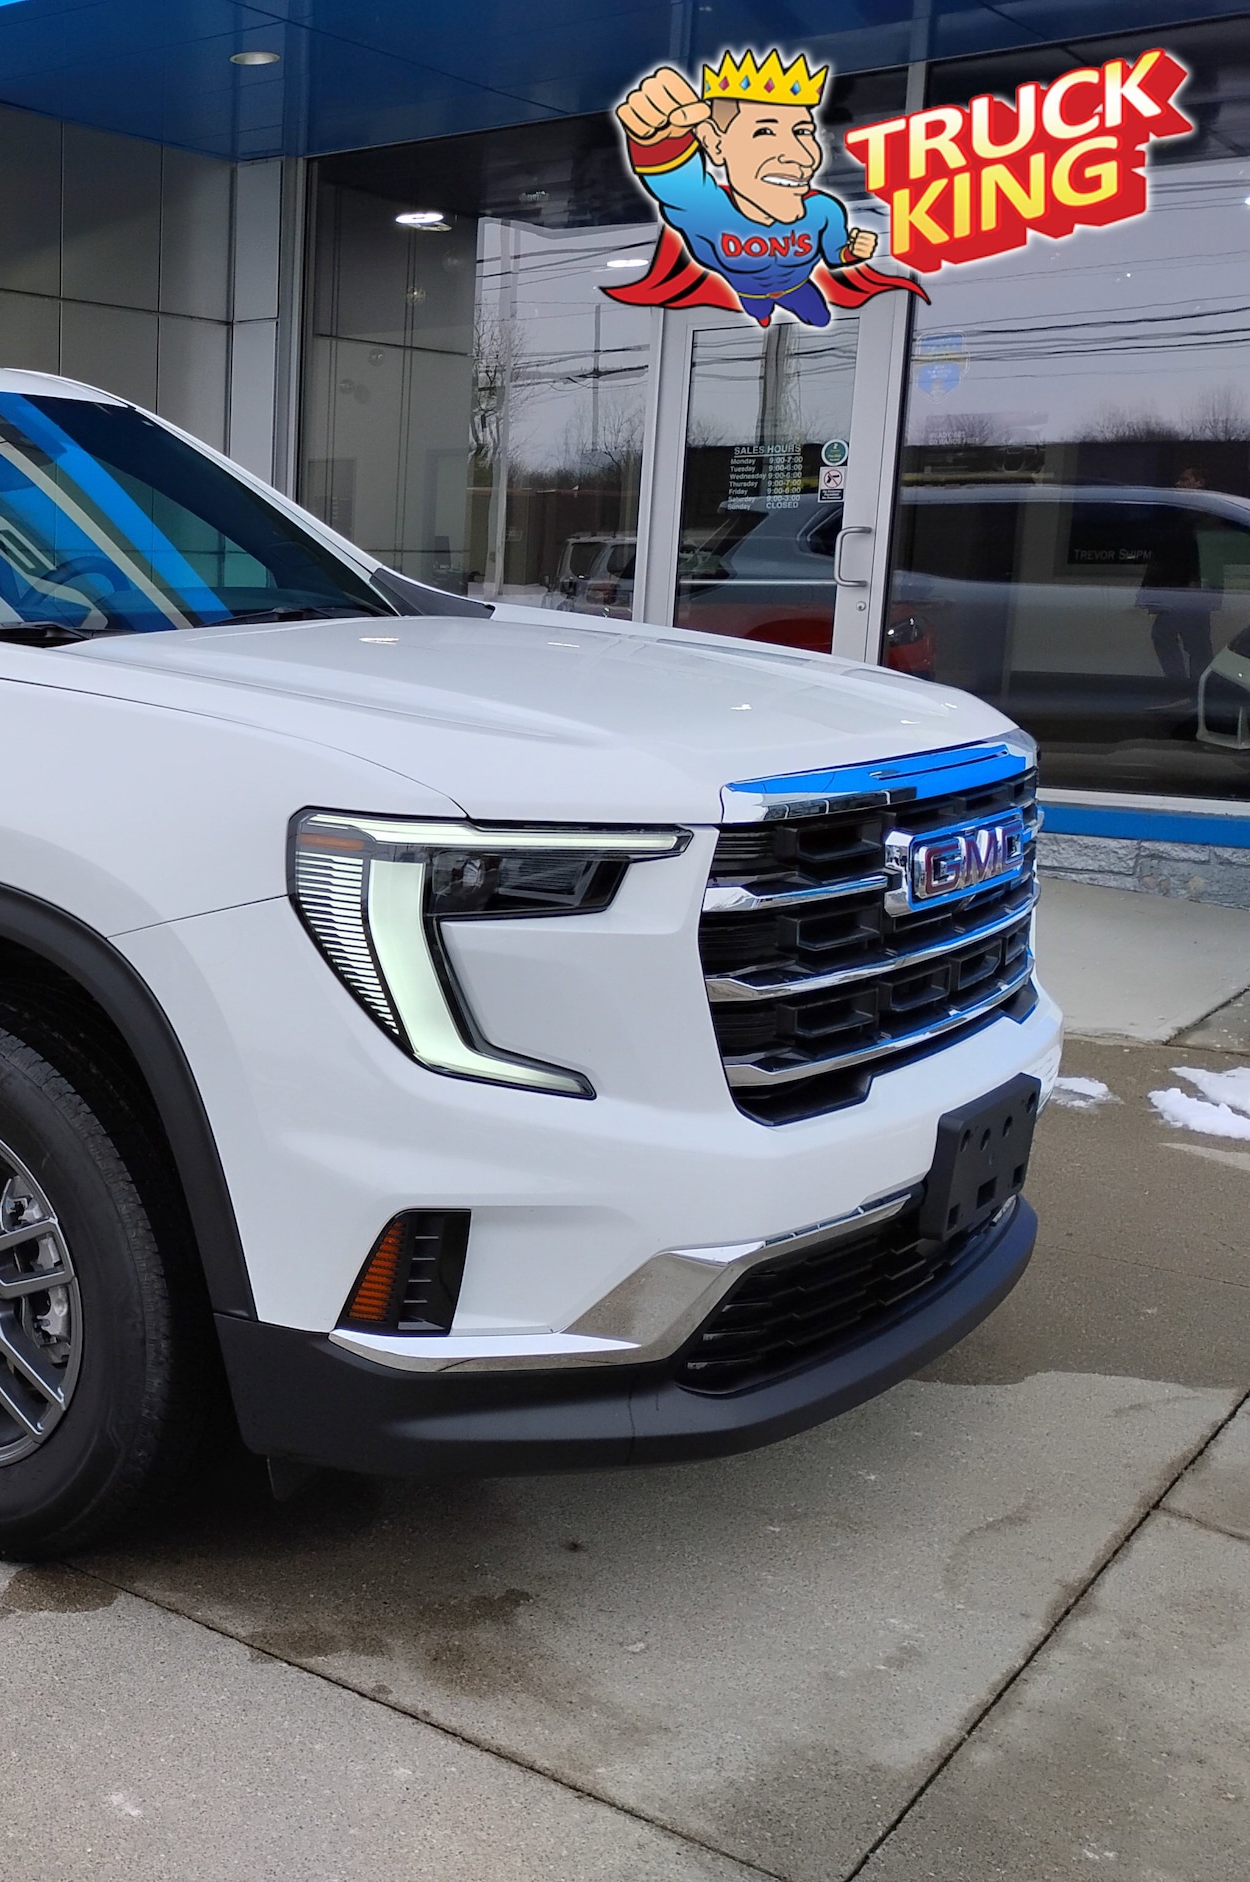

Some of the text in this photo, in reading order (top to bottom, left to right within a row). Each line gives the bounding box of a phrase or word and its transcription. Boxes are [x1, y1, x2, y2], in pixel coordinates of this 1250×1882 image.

[734, 444, 801, 455] SALES HOURS
[730, 456, 803, 466] Monday 9:00-7:00
[730, 465, 756, 473] Tuesday
[729, 472, 767, 481] Wednesday
[729, 479, 802, 488] Thursday 9:00-7:00
[728, 488, 748, 496] Friday
[727, 501, 799, 511] Sunday CLOSED
[1074, 549, 1115, 561] TREVOR
[918, 821, 1024, 899] GMC
